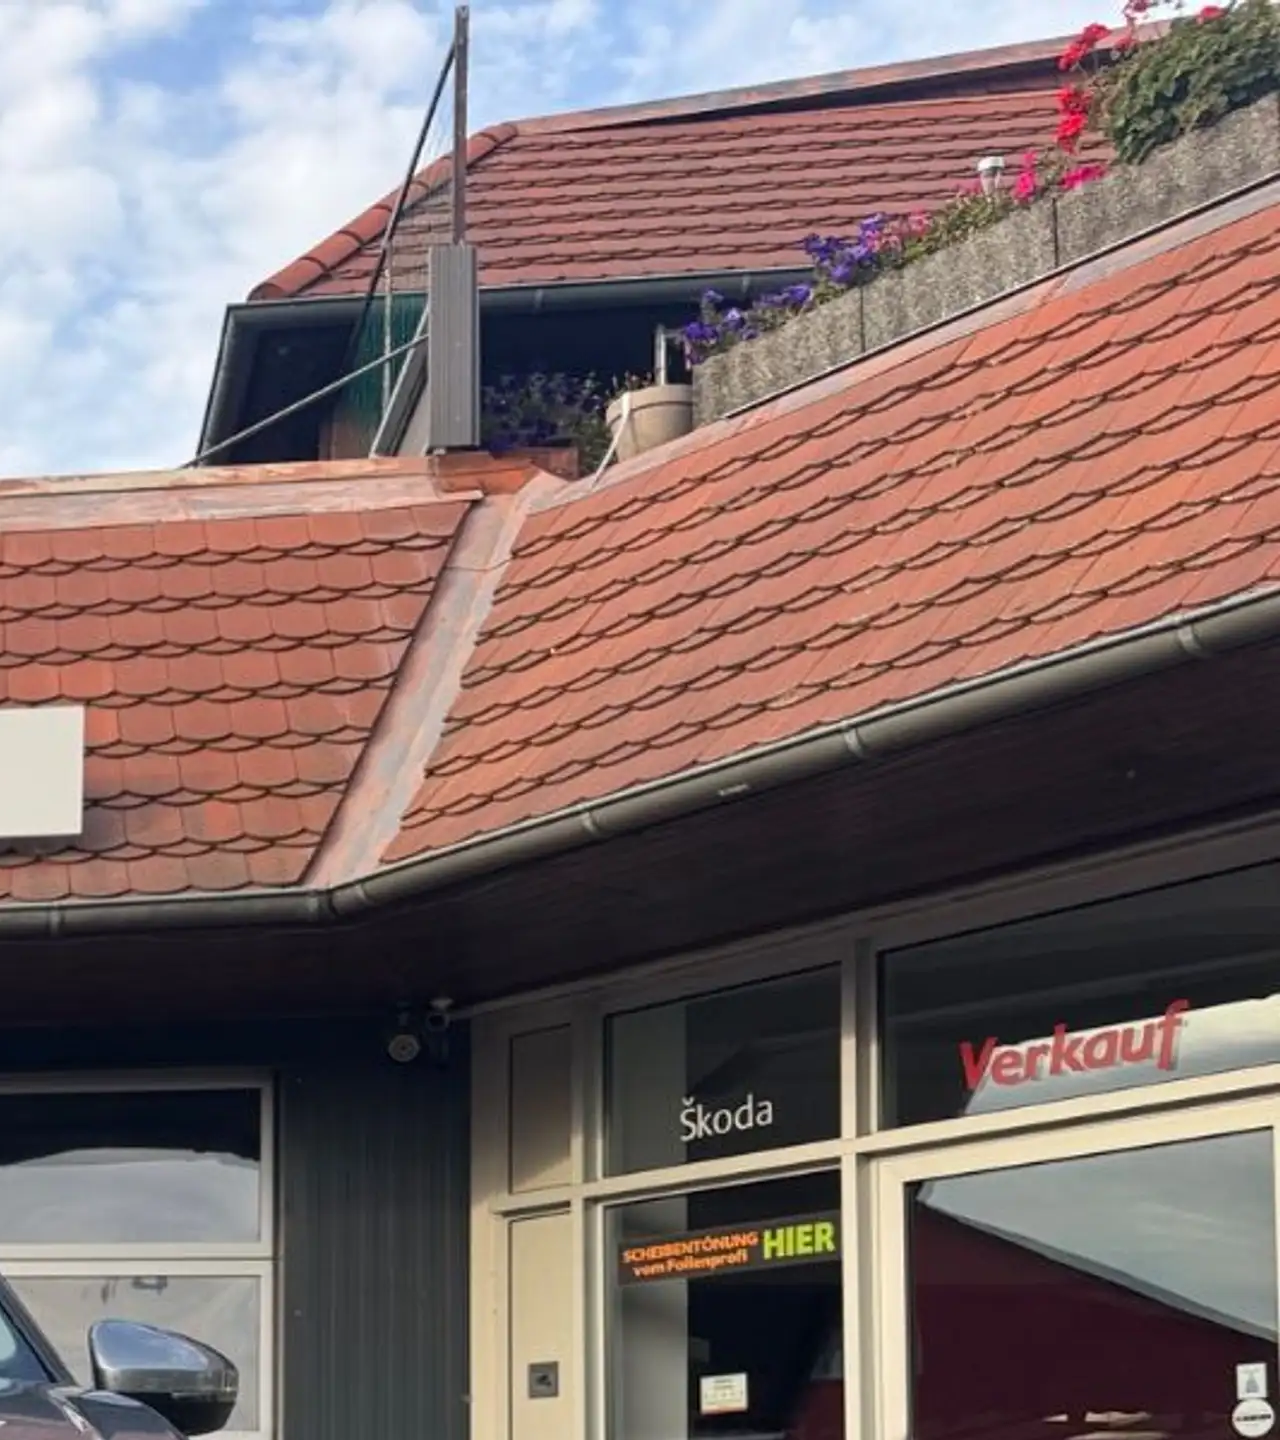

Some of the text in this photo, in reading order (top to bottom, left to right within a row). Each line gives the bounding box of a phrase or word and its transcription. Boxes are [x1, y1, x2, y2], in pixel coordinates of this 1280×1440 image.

[958, 999, 1190, 1090] Verkauf
[679, 1094, 774, 1142] Škoda
[762, 1221, 836, 1261] HIER
[632, 1262, 665, 1277] vom
